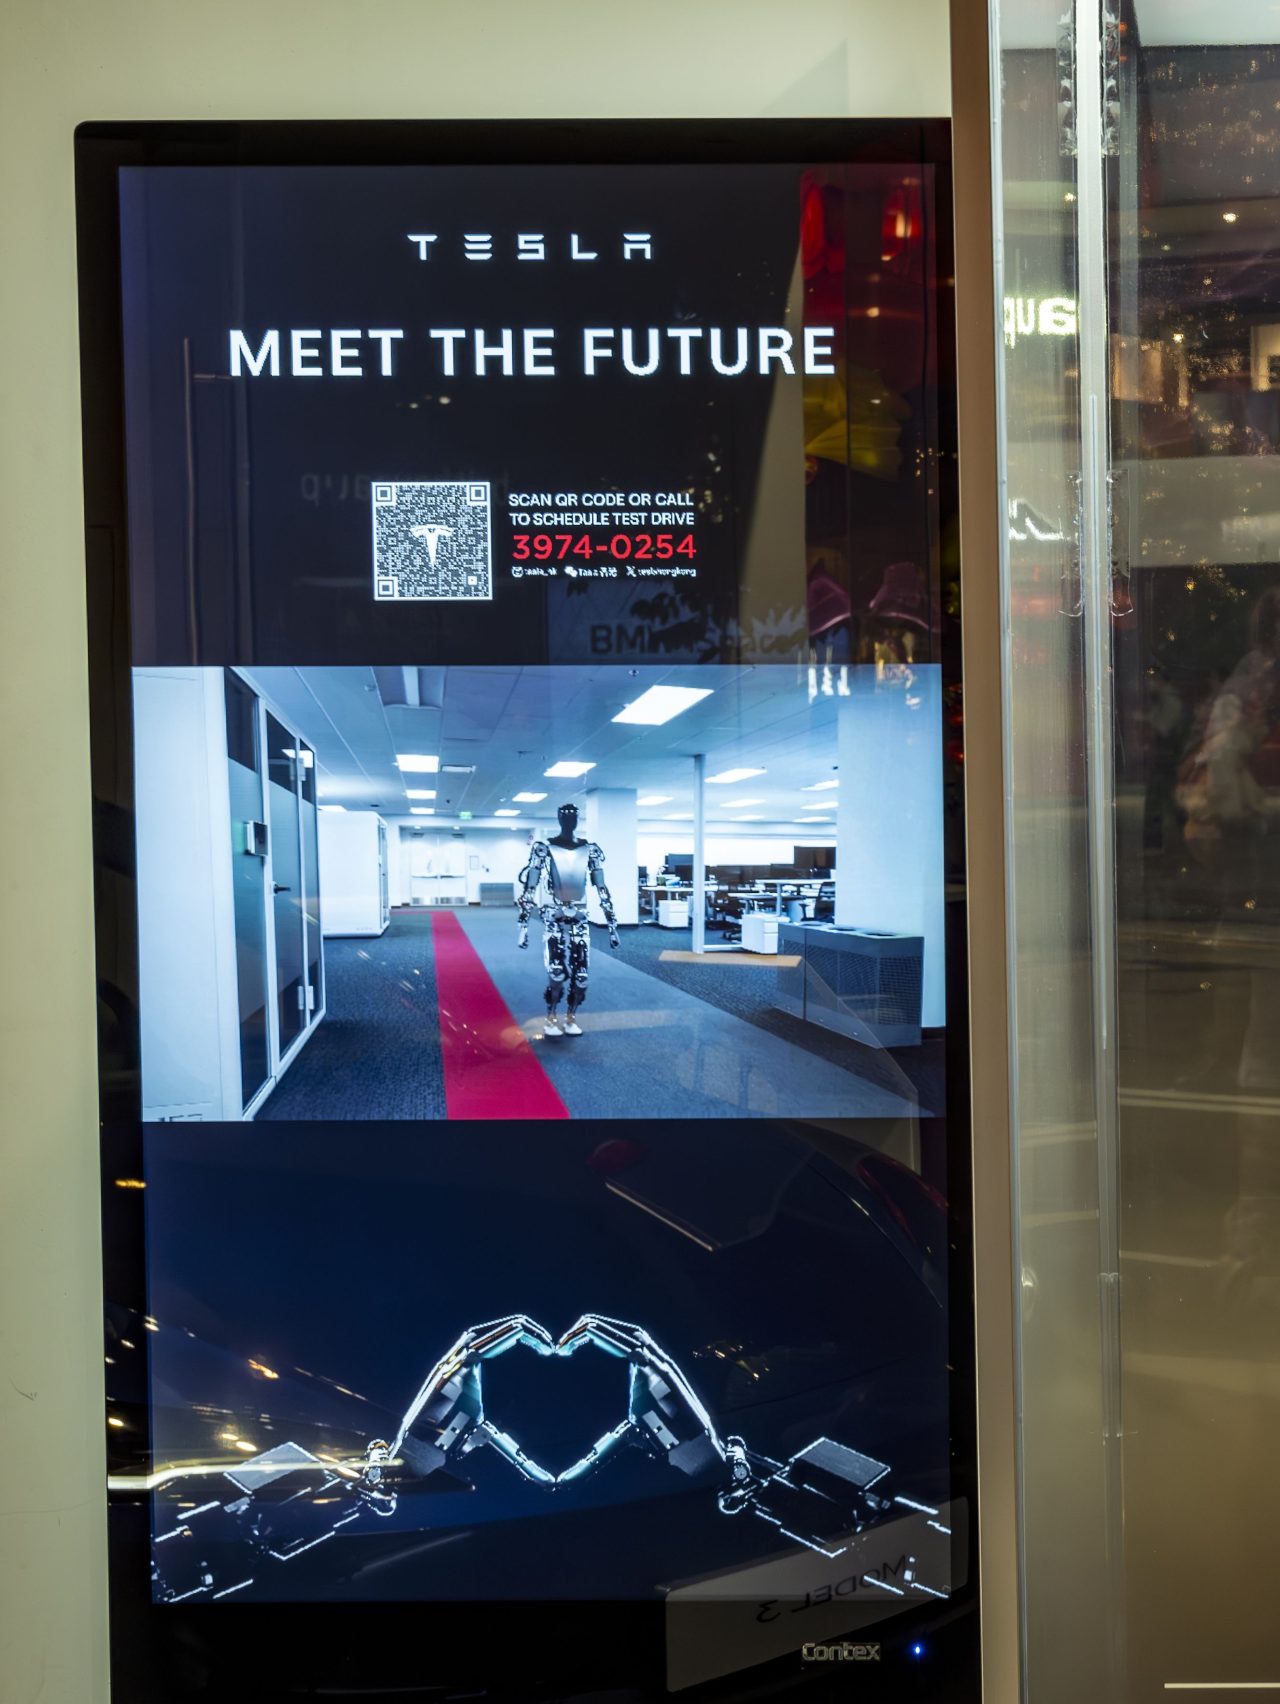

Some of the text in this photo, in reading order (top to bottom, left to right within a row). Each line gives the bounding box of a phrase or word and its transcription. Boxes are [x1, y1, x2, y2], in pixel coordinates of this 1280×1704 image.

[406, 233, 652, 261] TESLA
[229, 327, 835, 377] MEET THE FUTURE
[508, 493, 694, 507] SCAN QR CODE OR CALL
[509, 512, 695, 526] TO SCHEDULE TEST DRIVE
[512, 534, 697, 560] 3974-0254
[801, 1641, 881, 1661] Contex
